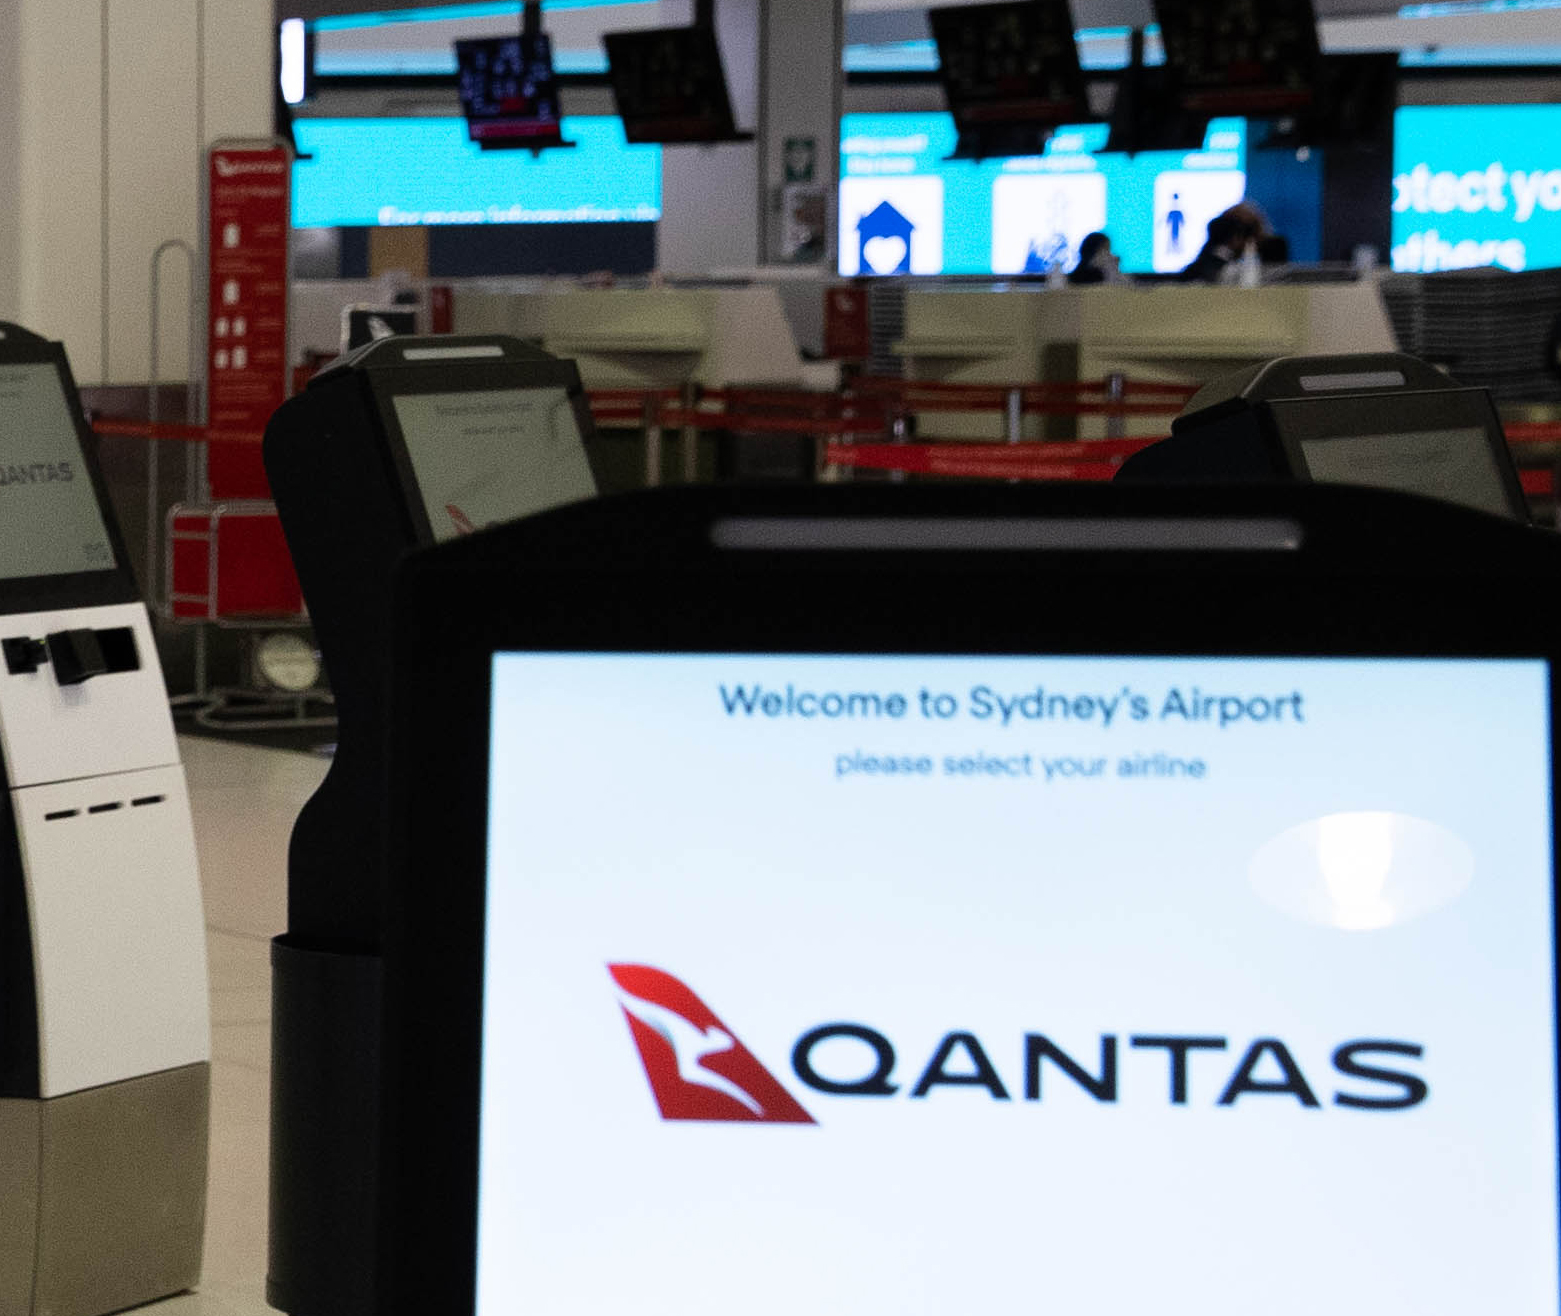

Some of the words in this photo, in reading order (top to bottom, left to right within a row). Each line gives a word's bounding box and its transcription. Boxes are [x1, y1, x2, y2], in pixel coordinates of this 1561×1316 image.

[717, 684, 909, 720] Welcome
[919, 688, 959, 720] to
[969, 685, 1151, 728] Sydney's
[1159, 687, 1306, 729] Airport
[834, 749, 934, 778] please
[942, 750, 1034, 777] select
[1043, 757, 1107, 782] your
[1116, 751, 1208, 780] airline
[790, 1020, 1432, 1111] QANTAS
